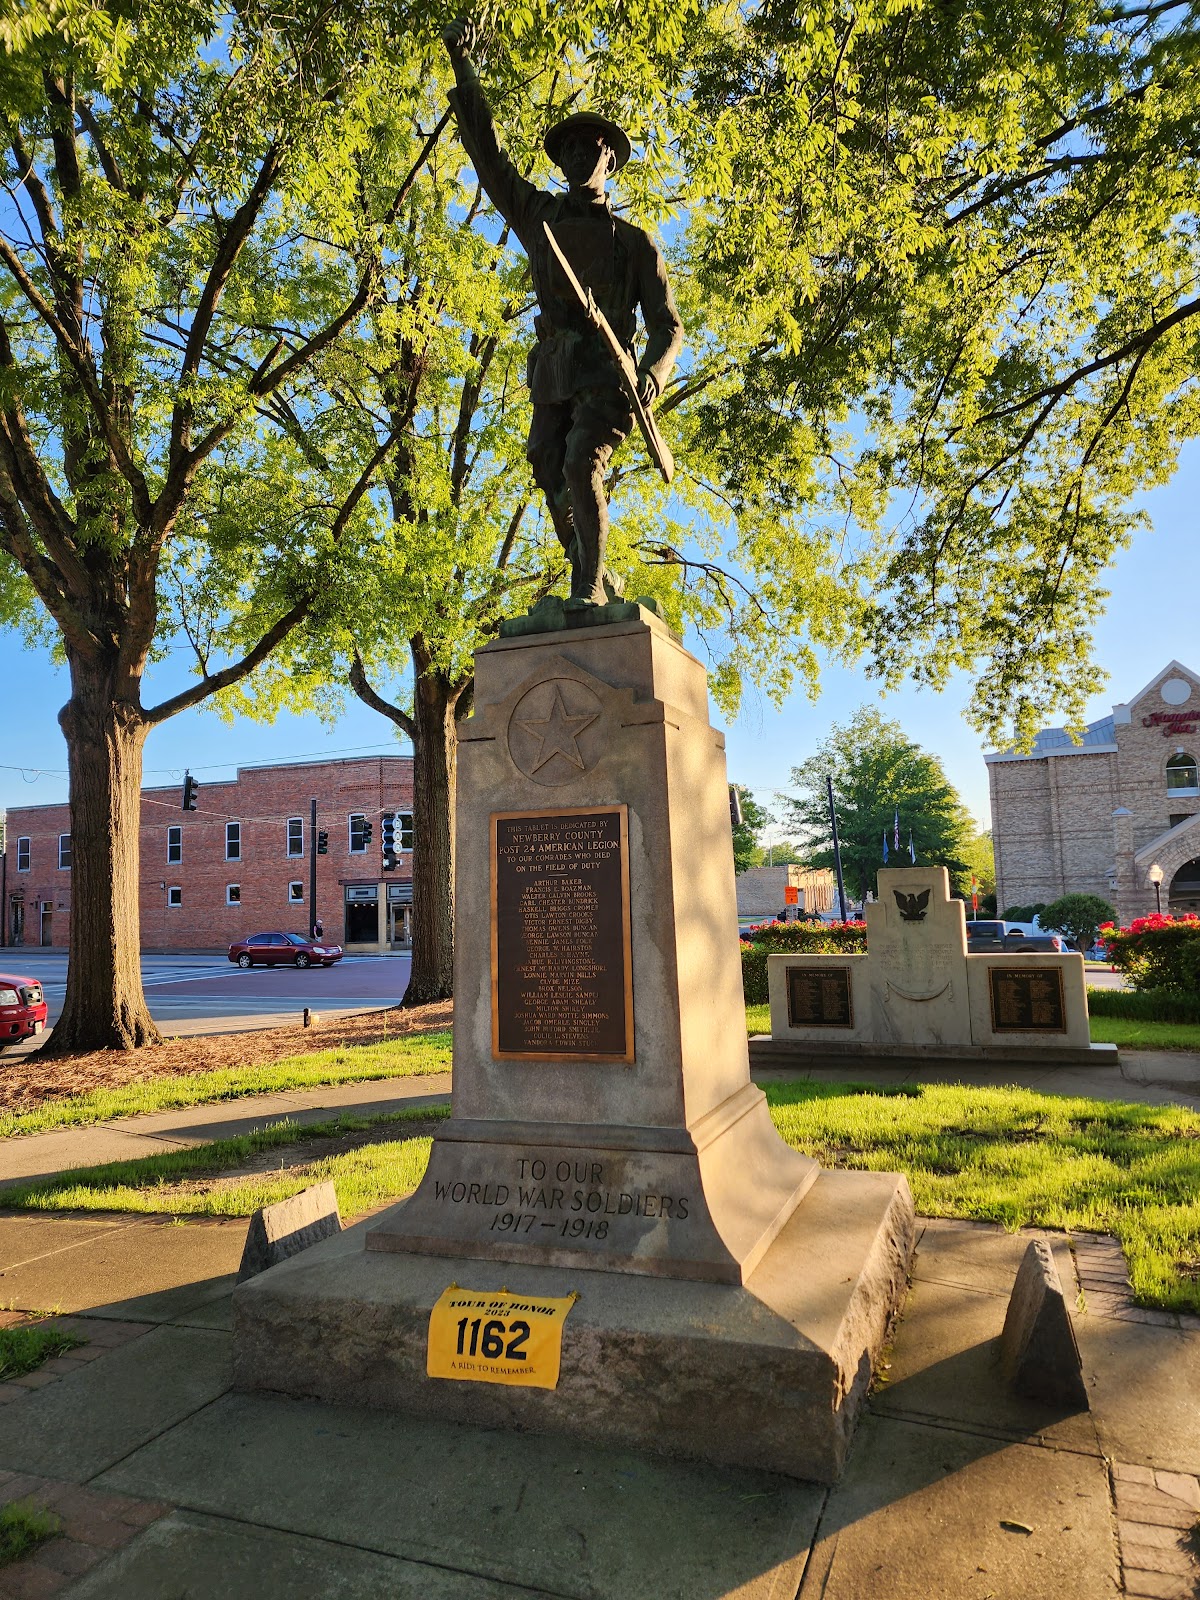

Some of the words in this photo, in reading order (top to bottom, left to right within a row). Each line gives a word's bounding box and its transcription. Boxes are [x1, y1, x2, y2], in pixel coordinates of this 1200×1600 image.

[560, 822, 596, 830] DEDICATED
[512, 832, 560, 843] NEWBERRY
[565, 830, 603, 840] COUNTY
[499, 846, 520, 854] POST
[538, 842, 584, 852] AMERICAN
[517, 1158, 546, 1181] TO
[556, 1161, 603, 1184] OUR
[434, 1181, 510, 1206] WORLD
[518, 1186, 564, 1210] WAR
[570, 1190, 689, 1220] SOLDIERS
[484, 1309, 511, 1317] 2023
[508, 1302, 556, 1316] HONOR
[456, 1318, 530, 1360] 1162
